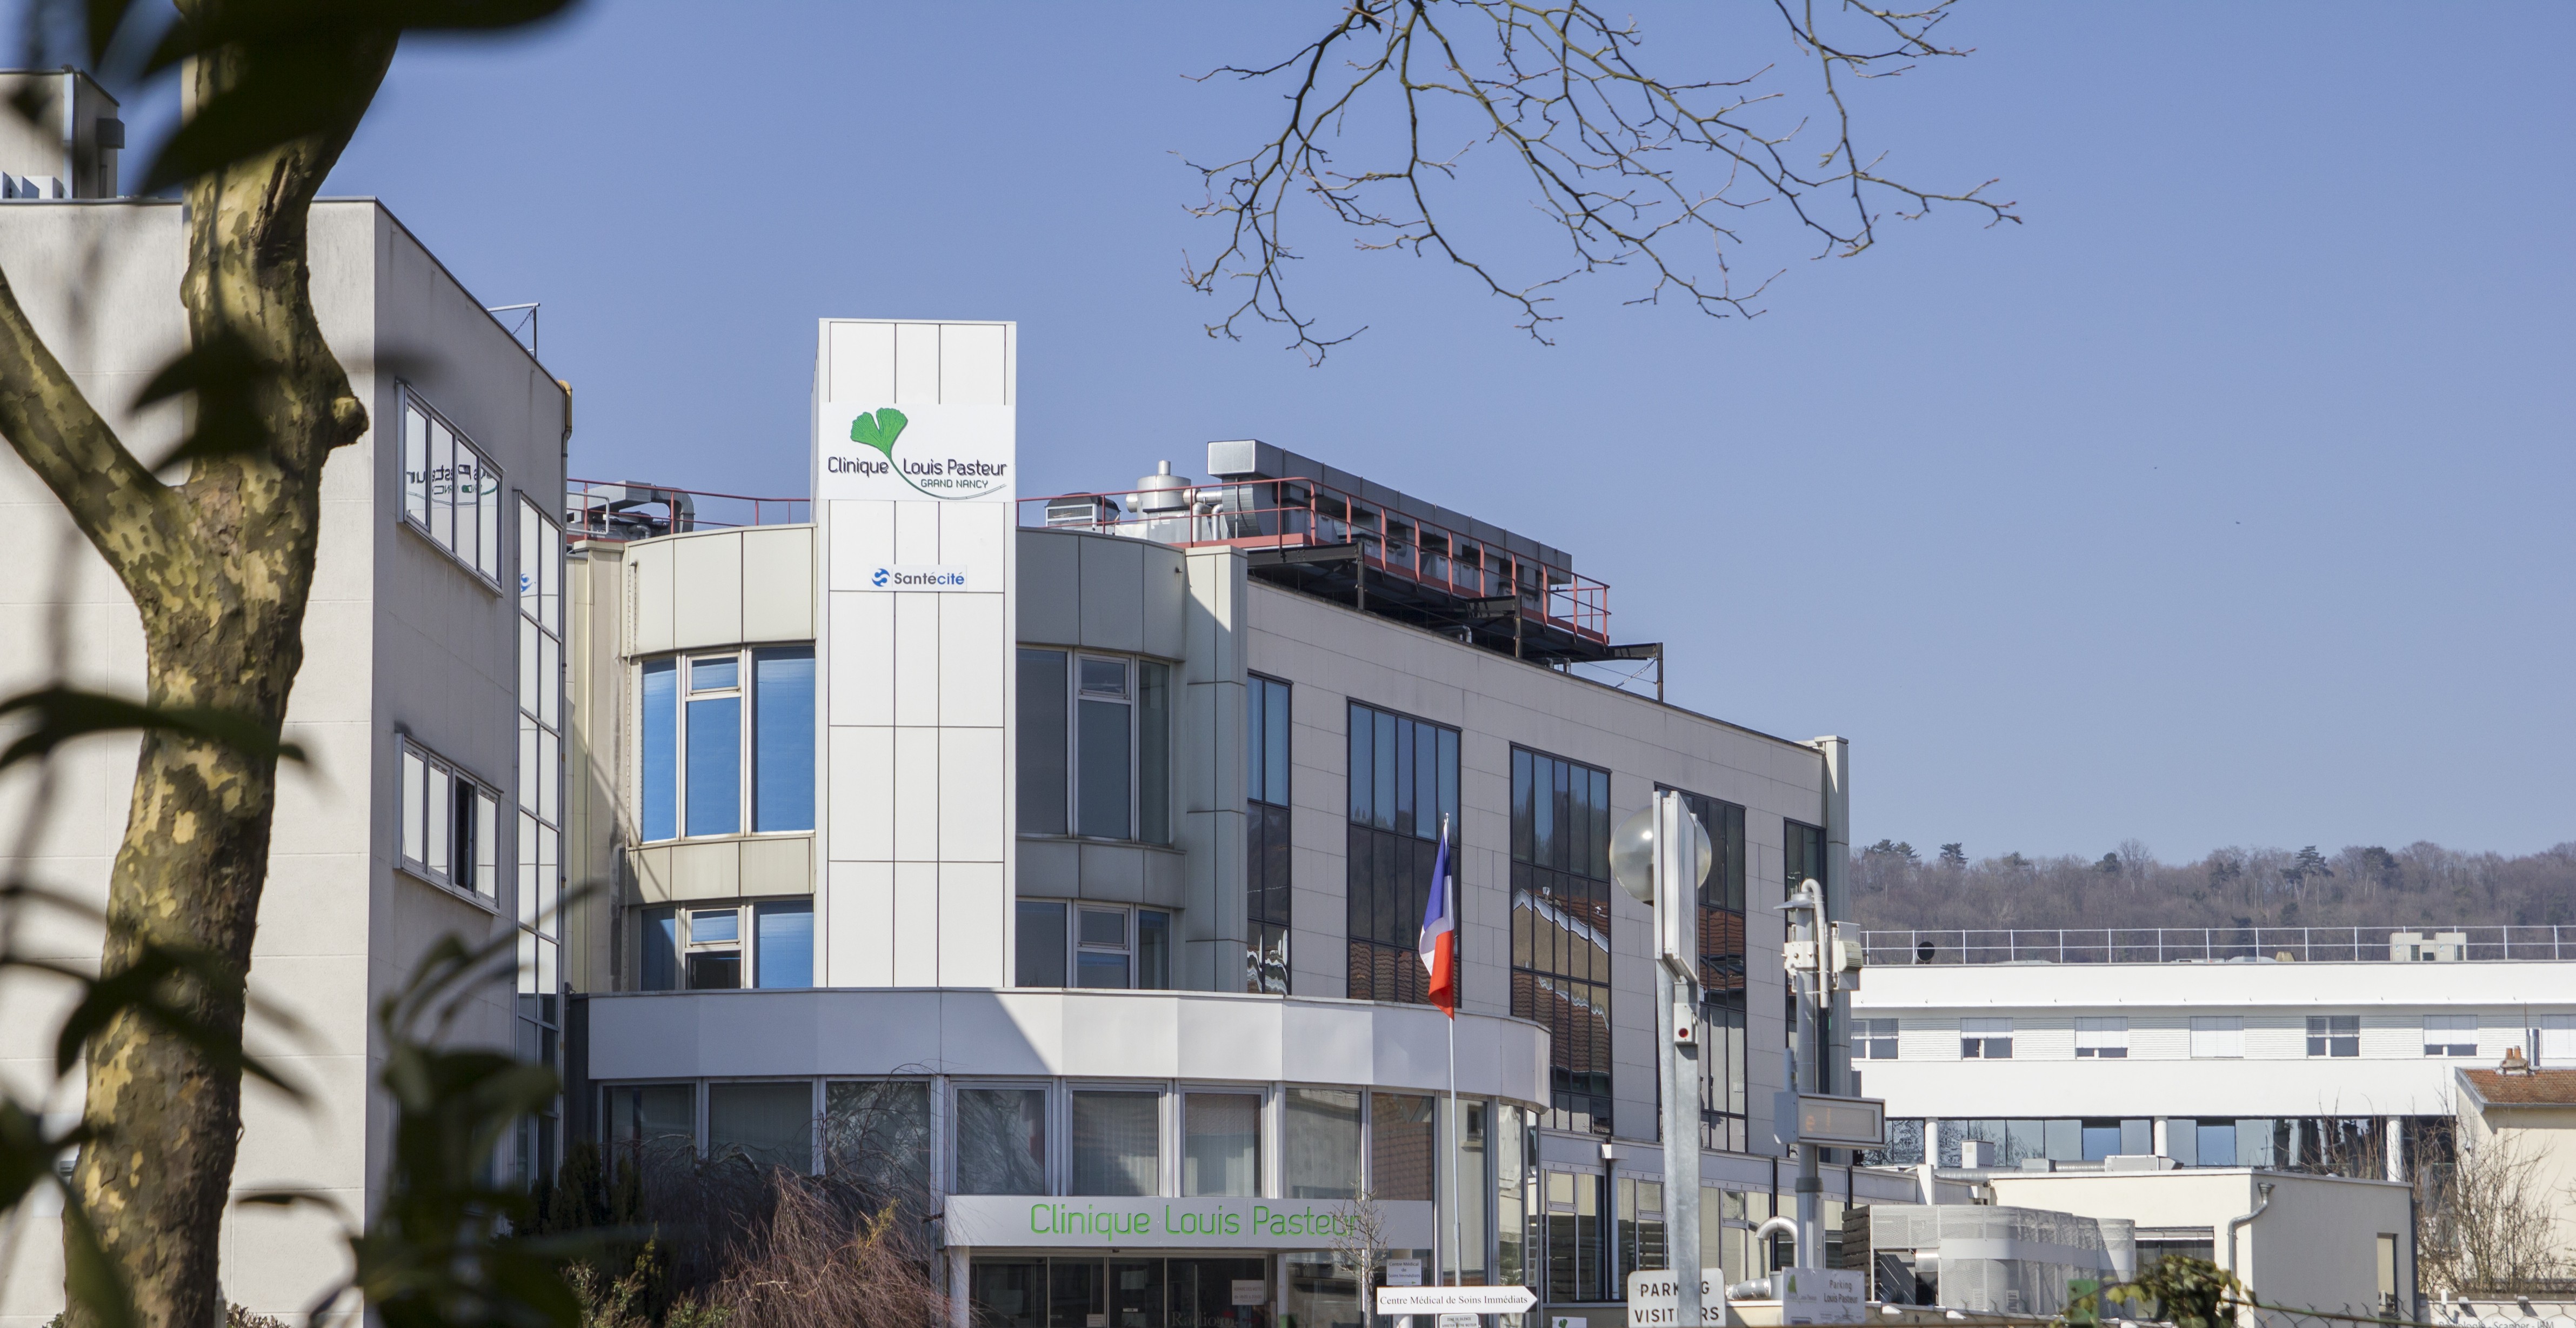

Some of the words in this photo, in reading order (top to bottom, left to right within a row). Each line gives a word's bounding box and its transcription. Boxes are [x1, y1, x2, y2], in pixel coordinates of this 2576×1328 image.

[828, 456, 889, 477] Clinique
[903, 458, 943, 475] Louis
[947, 458, 1007, 476] Pasteur
[920, 479, 953, 488] GRAND
[956, 479, 988, 489] NANCY
[894, 571, 965, 585] Santécité
[1031, 1203, 1150, 1242] Clinique
[1165, 1205, 1240, 1235] Louis
[1253, 1206, 1359, 1236] Pasteur
[1640, 1281, 1710, 1297] PARKG
[1829, 1279, 1852, 1292] Parking
[1380, 1296, 1407, 1305] Centre
[1410, 1295, 1444, 1304] Médical
[1446, 1295, 1456, 1304] de
[1459, 1295, 1481, 1304] Soins
[1484, 1294, 1527, 1304] Immédiats
[1824, 1293, 1838, 1303] Louis
[1839, 1293, 1858, 1304] Pasteur
[1634, 1307, 1719, 1323] VISITRS
